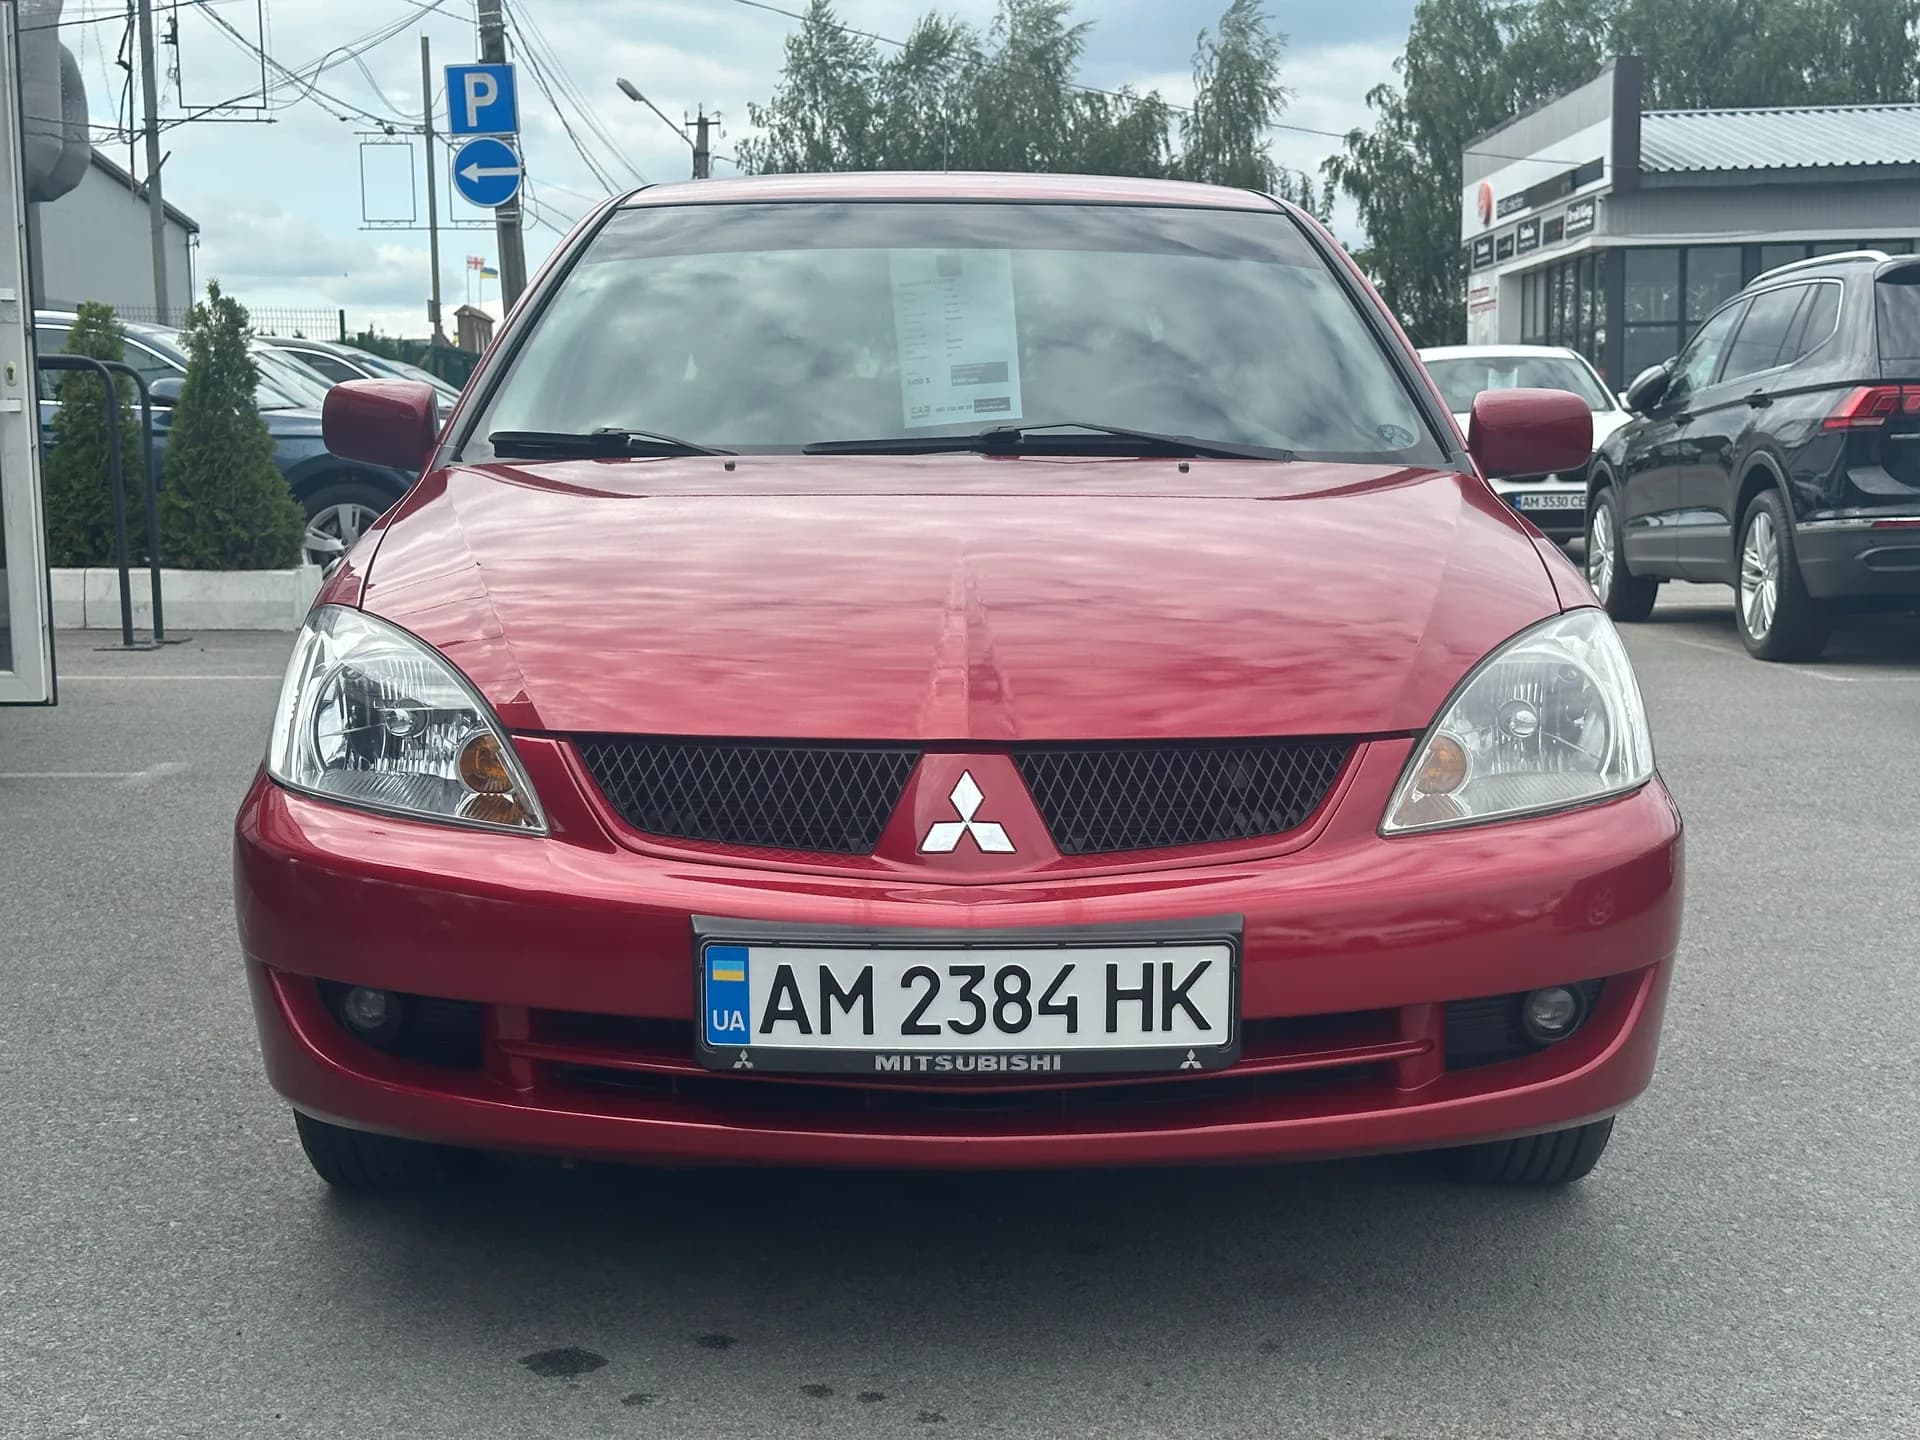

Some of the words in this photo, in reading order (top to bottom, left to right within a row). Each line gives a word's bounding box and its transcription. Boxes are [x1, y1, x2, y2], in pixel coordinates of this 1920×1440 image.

[464, 72, 499, 128] P
[1522, 496, 1539, 508] AM
[1542, 496, 1568, 508] 3530
[759, 964, 874, 1036] AM
[900, 963, 1078, 1036] 2384
[1105, 960, 1213, 1034] HK
[713, 1010, 746, 1032] UA
[874, 1053, 1062, 1073] MITSUBISHI
